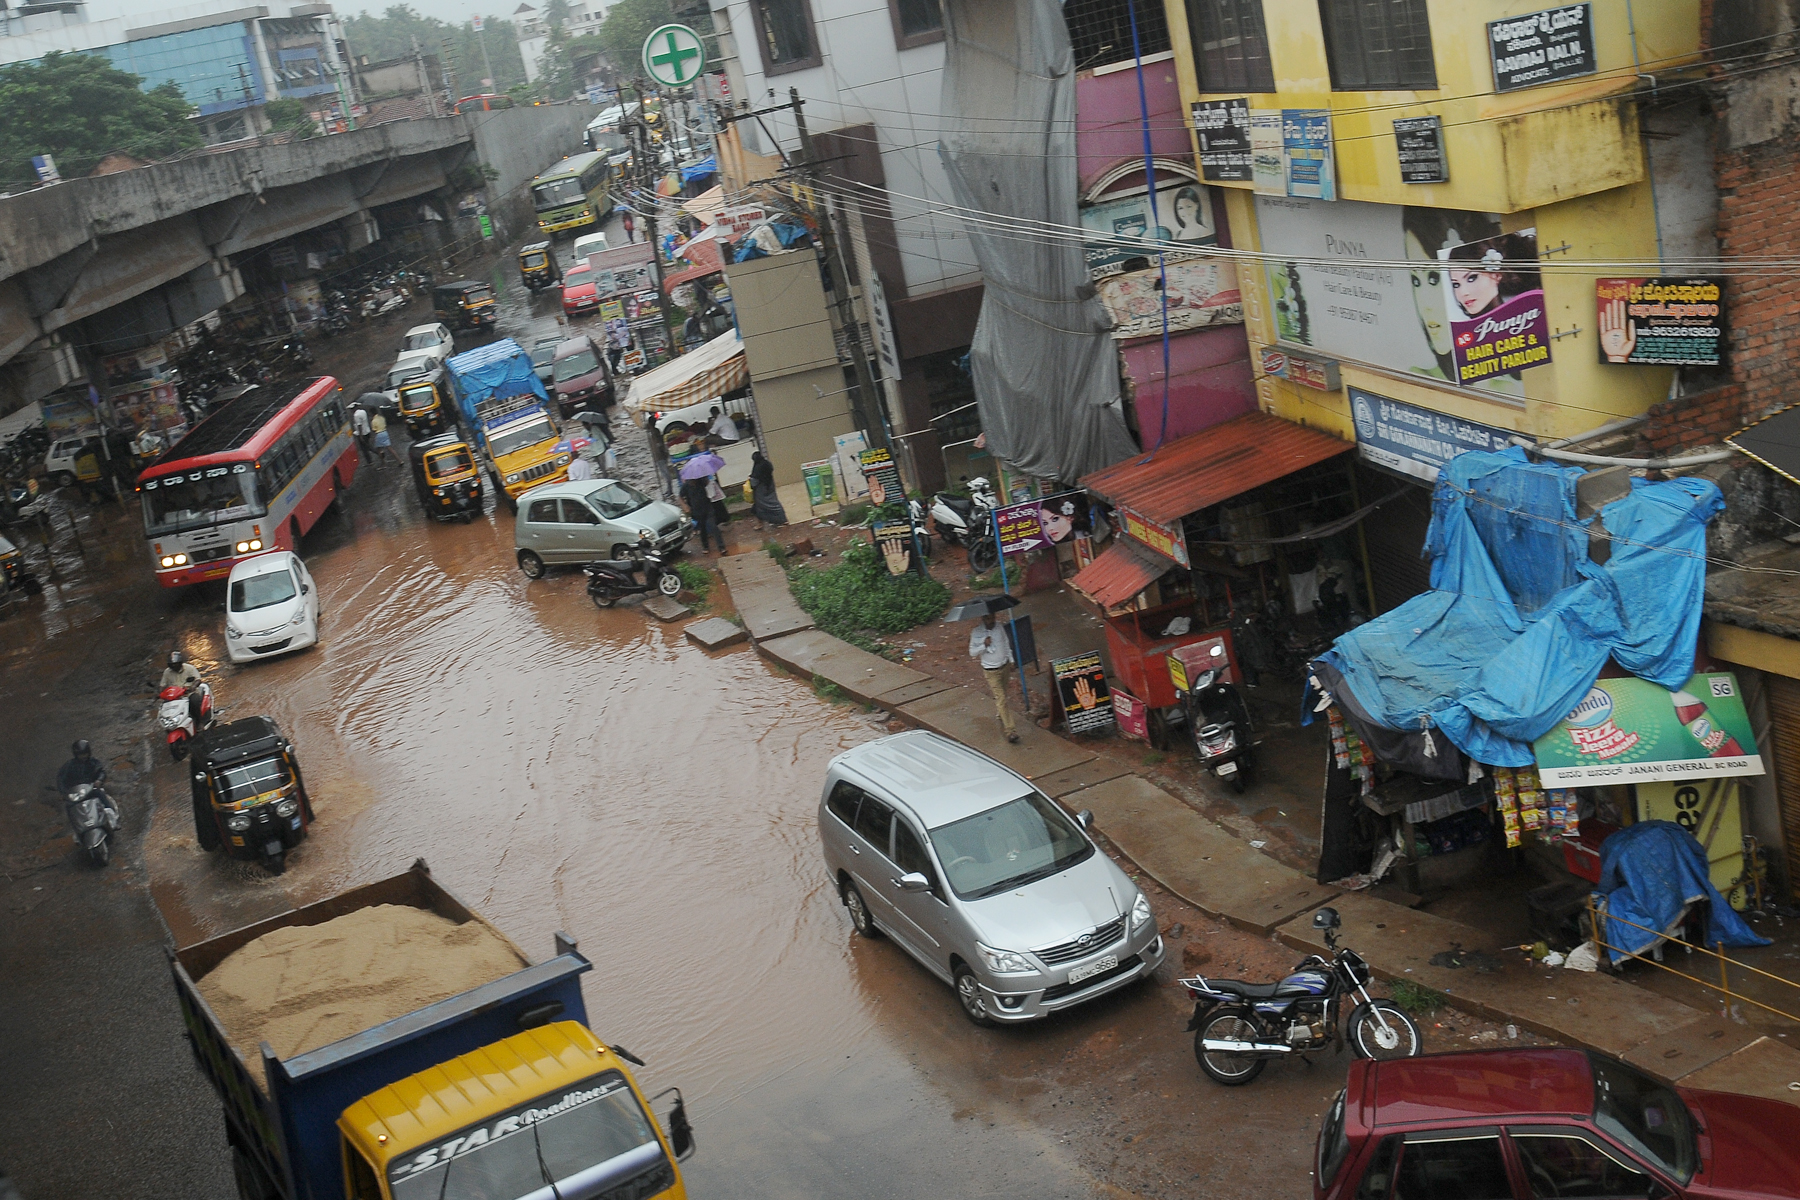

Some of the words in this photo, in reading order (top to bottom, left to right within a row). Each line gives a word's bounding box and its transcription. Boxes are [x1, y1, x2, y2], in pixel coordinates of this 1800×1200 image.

[1474, 308, 1542, 342] Punya
[1466, 343, 1495, 361] HAIR
[1495, 335, 1526, 353] CARE
[1528, 334, 1538, 345] &
[1460, 358, 1500, 380] BEAUTY
[1501, 346, 1548, 369] PARLOUR
[1571, 721, 1616, 742] Fizz
[1581, 730, 1626, 753] Jeera
[1599, 734, 1638, 759] Masala
[1628, 765, 1664, 776] JANANI
[410, 1115, 521, 1173] STAR
[518, 1085, 609, 1125] Roadlines
